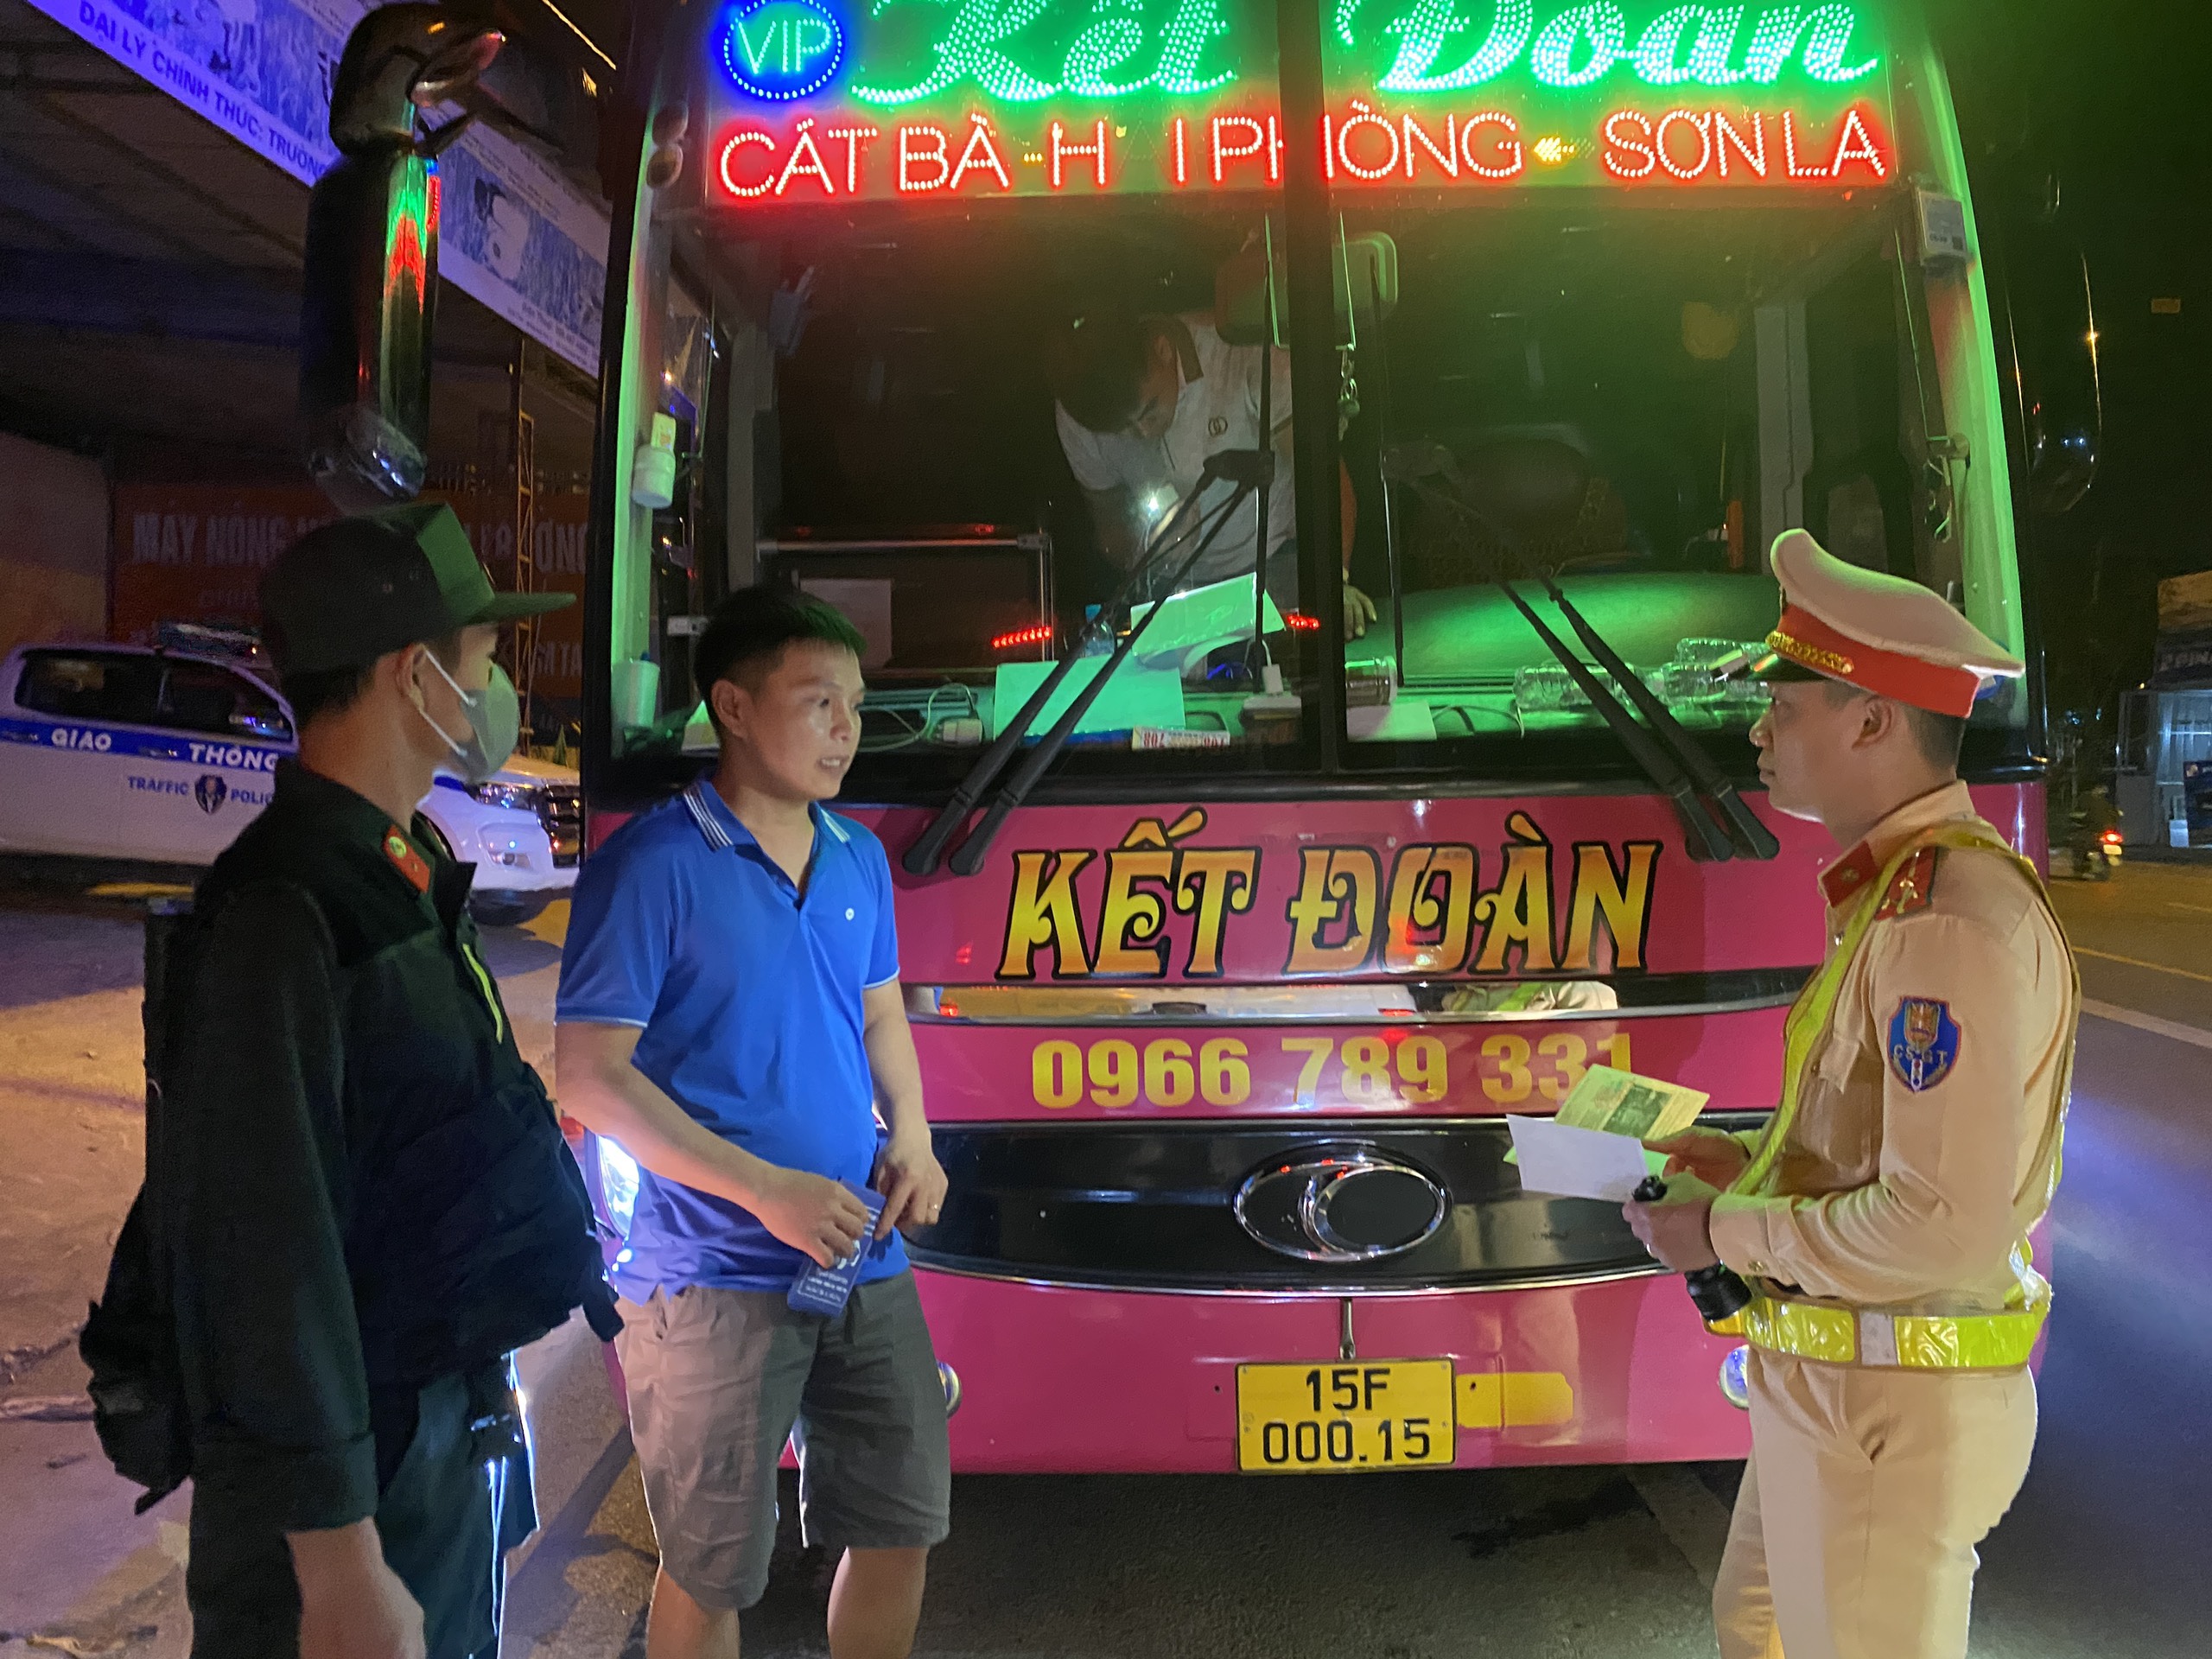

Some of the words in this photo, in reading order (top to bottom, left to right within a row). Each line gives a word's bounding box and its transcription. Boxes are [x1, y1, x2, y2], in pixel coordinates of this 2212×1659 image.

[737, 19, 832, 75] VIP
[721, 118, 878, 197] CÁT
[899, 113, 1010, 191] BÀ
[51, 728, 112, 751] GIAO
[128, 775, 189, 796] TRAFFIC
[230, 787, 275, 807] POLIC
[995, 806, 1263, 979] KẾT
[1284, 809, 1665, 977] ĐOÀN
[1032, 1038, 1252, 1109] 0966
[1281, 1036, 1449, 1106] 789
[1480, 1032, 1632, 1104] 331
[1306, 1367, 1391, 1412] 15F
[1262, 1417, 1431, 1464] 000.15
